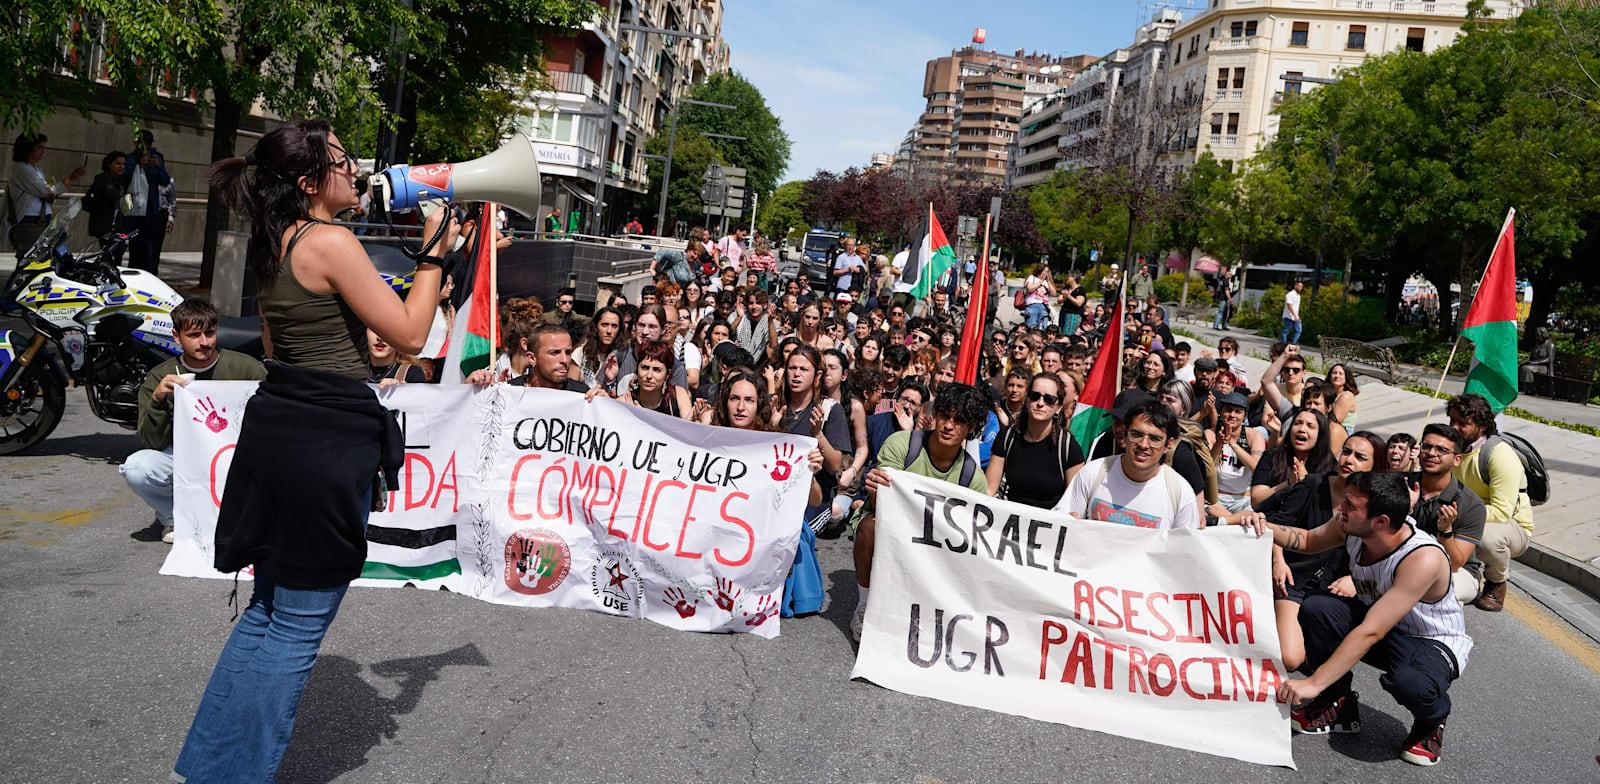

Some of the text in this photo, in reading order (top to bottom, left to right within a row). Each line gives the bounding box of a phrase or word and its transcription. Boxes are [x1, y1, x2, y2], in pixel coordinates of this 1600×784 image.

[632, 439, 668, 474] UE
[689, 450, 748, 491] UGR
[507, 453, 756, 568] CÓMPLICES
[911, 489, 1077, 577] ISRAEL
[603, 596, 629, 611] USE
[1073, 580, 1255, 645] ASESINA
[906, 603, 1288, 704] UGR PATROCINA
